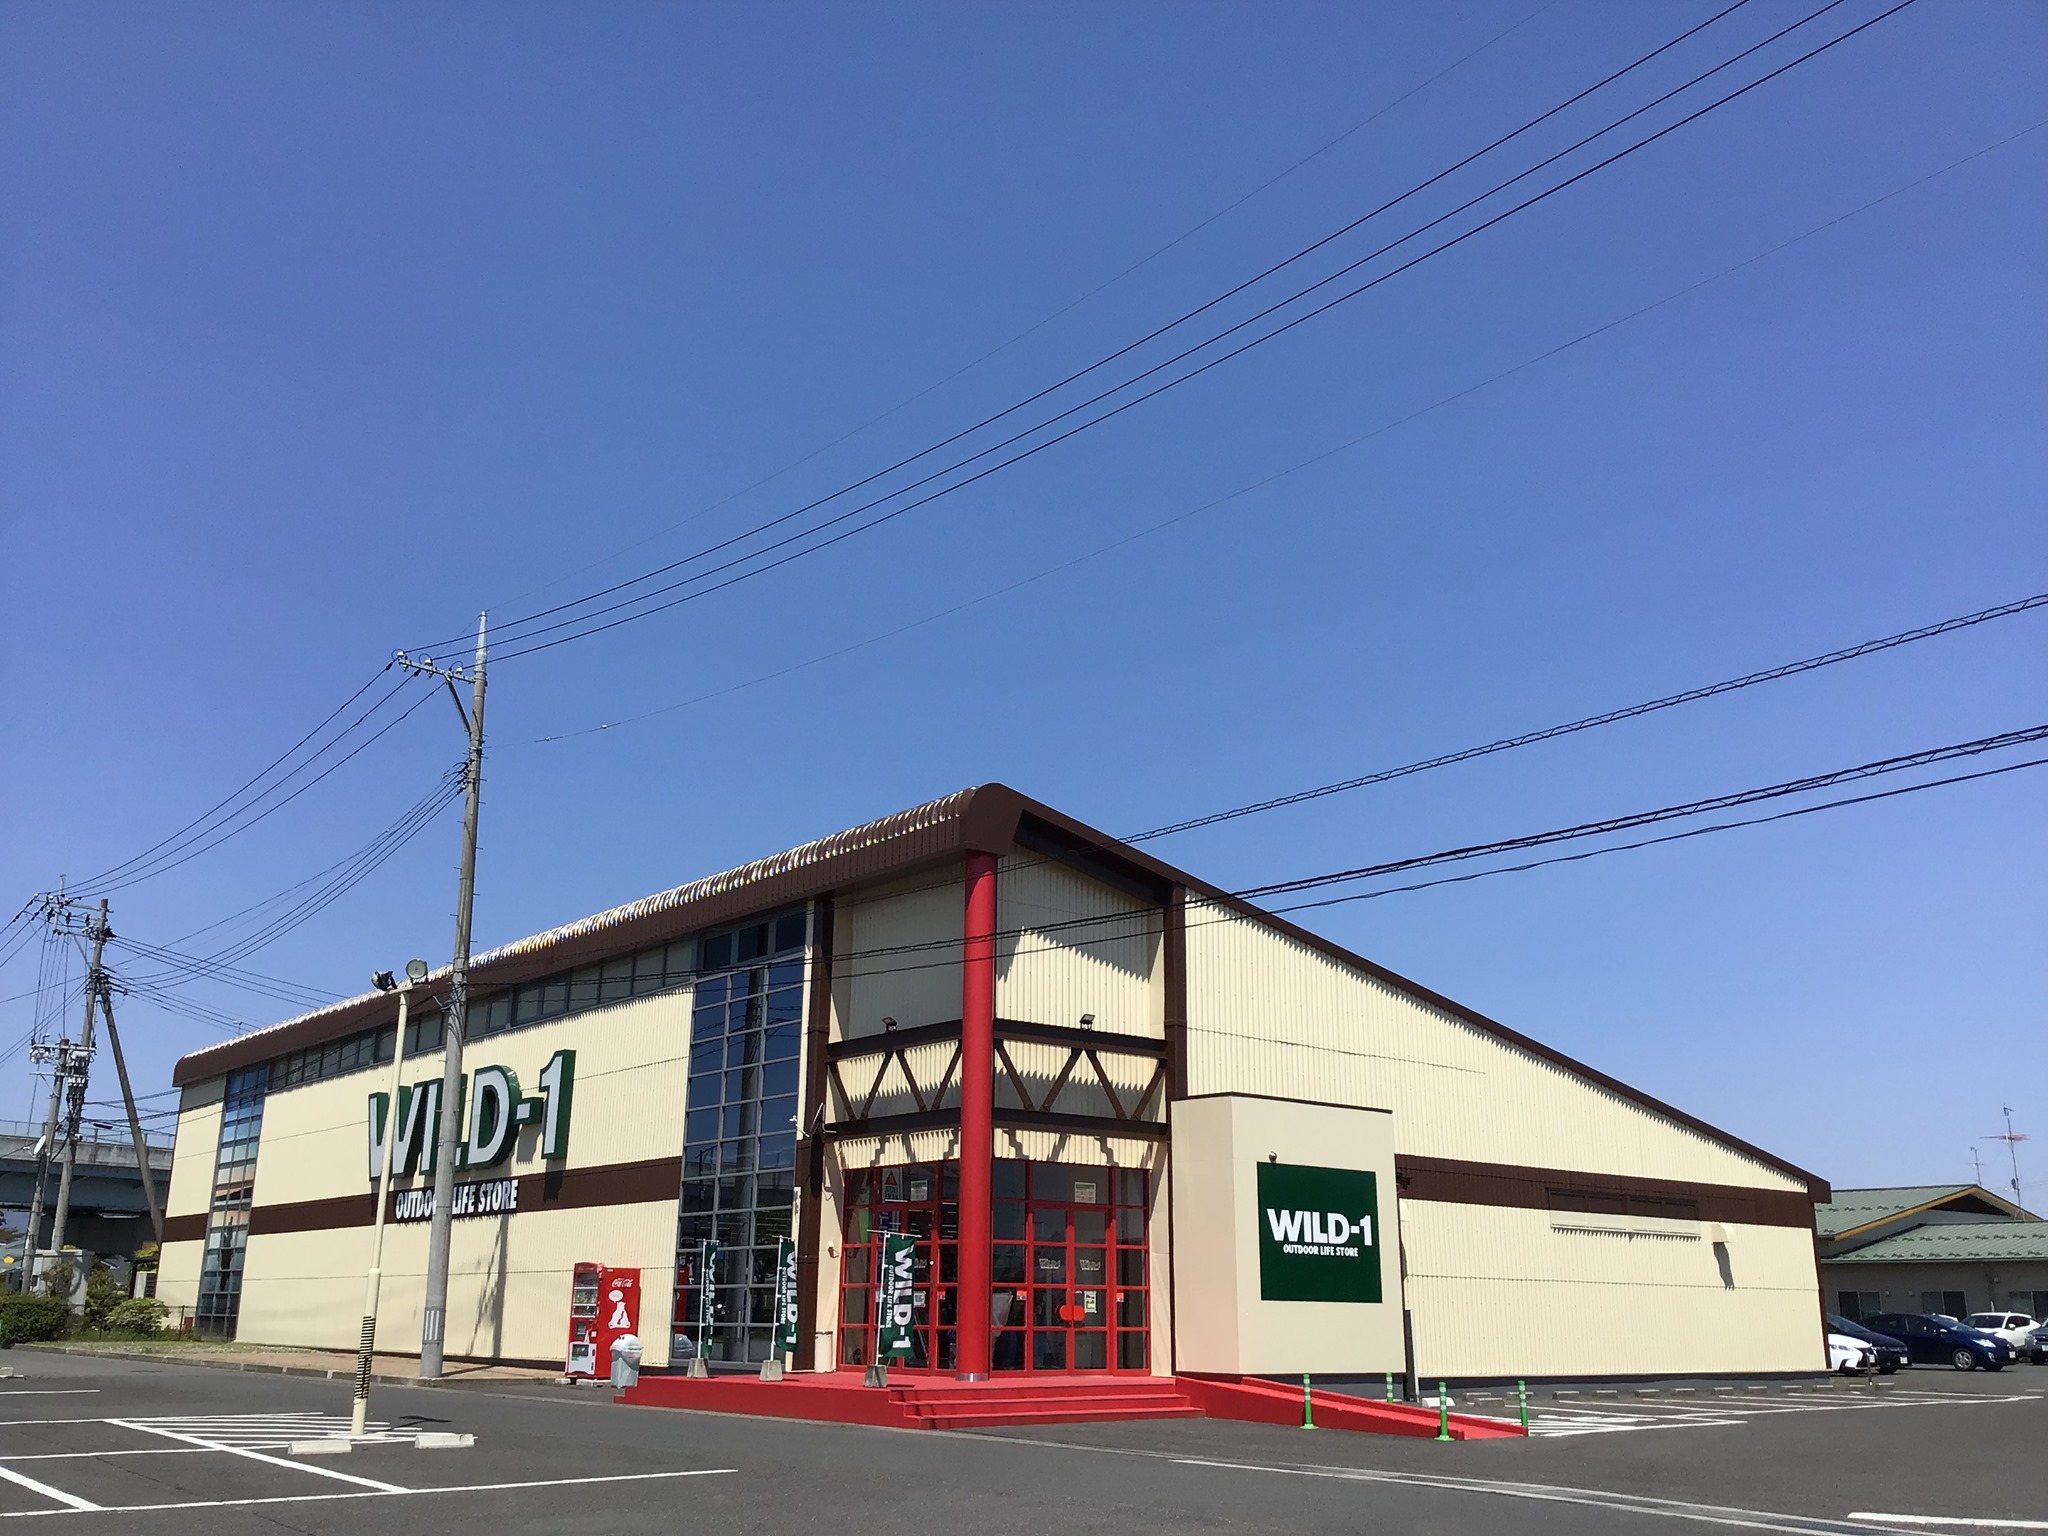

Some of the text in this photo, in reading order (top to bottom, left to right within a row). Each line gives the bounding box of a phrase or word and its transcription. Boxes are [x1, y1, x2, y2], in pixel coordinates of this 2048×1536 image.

[368, 1049, 576, 1181] WID-1
[395, 1179, 518, 1219] OUTDO LIFE STORE
[1266, 1208, 1373, 1246] WILD-1
[1283, 1244, 1359, 1257] OUTDOOR LIFE STORE
[892, 1244, 914, 1348] WILD-1
